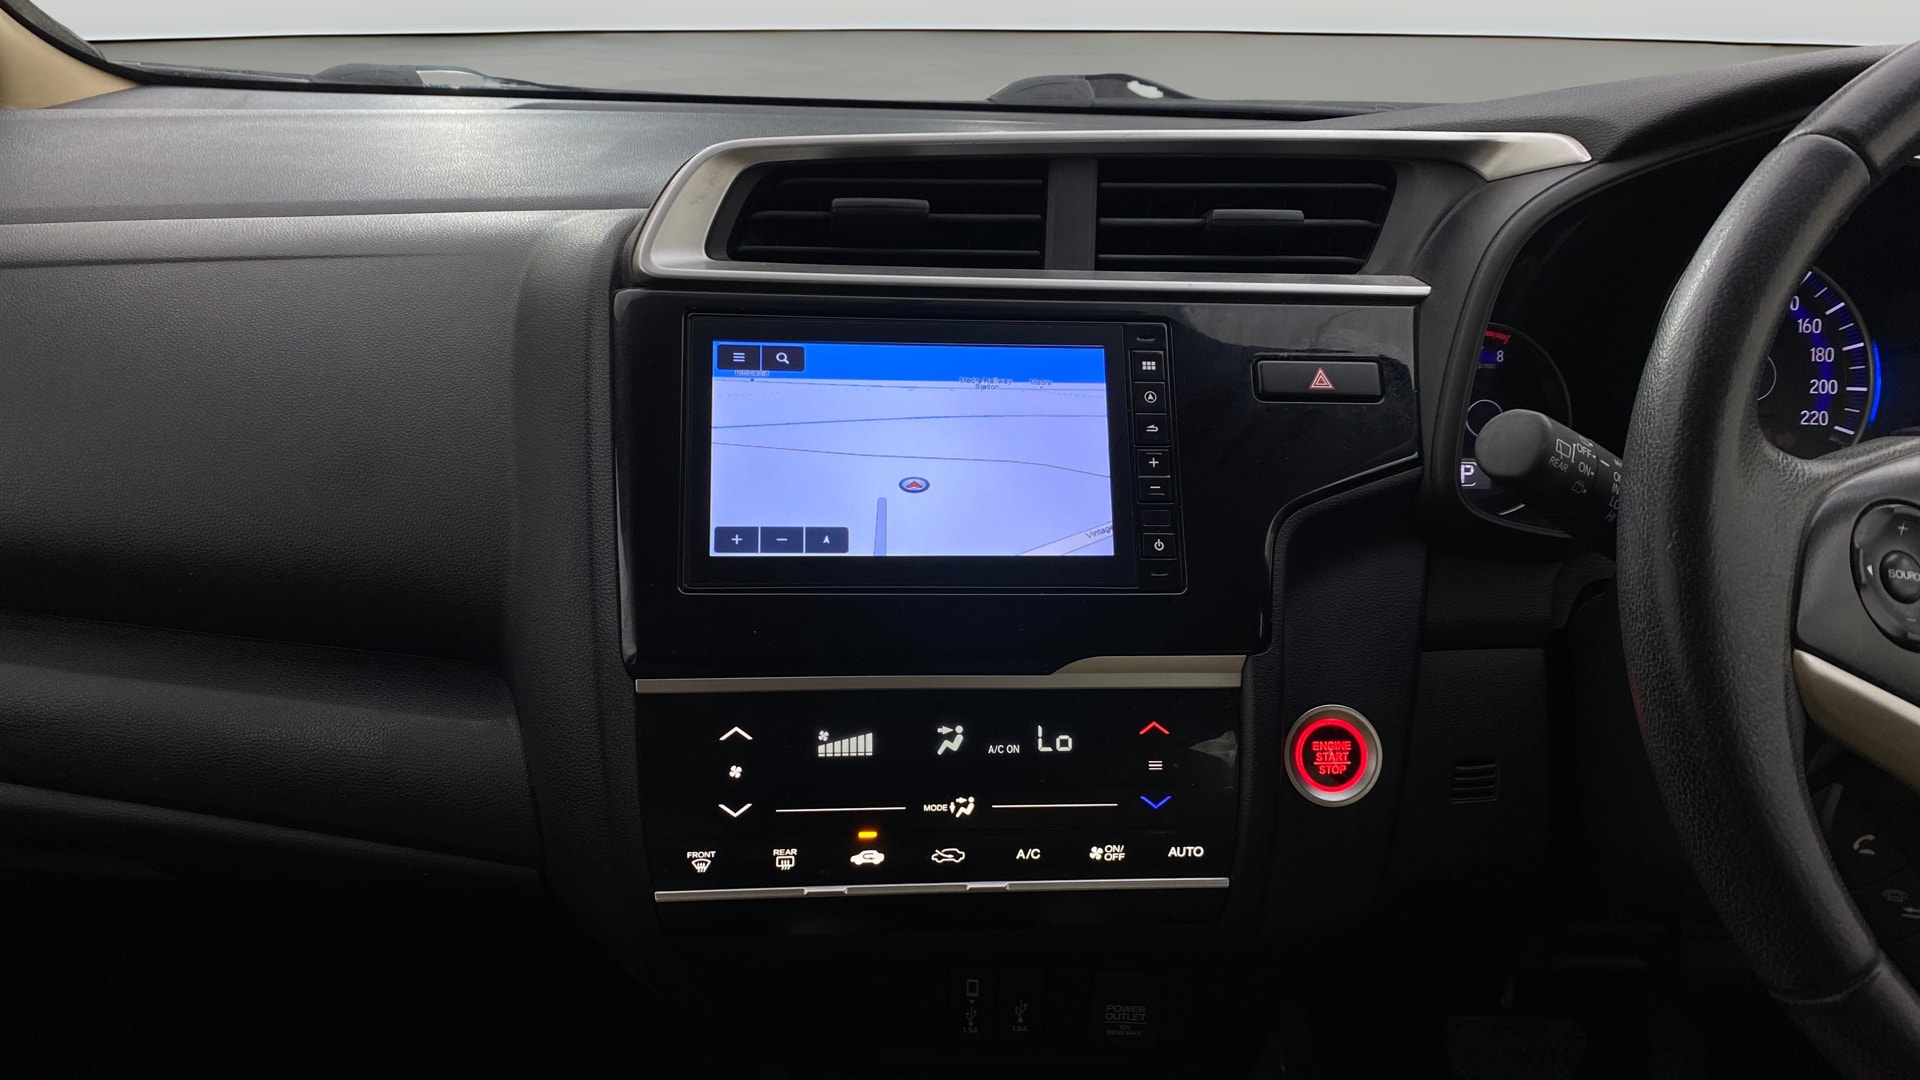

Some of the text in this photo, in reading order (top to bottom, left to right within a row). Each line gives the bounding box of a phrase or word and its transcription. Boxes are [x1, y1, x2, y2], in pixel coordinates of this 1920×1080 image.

[1797, 318, 1822, 334] 160
[1496, 350, 1504, 362] 8
[1810, 347, 1835, 363] 180
[1809, 379, 1838, 394] 200
[1800, 410, 1829, 426] 220
[1576, 443, 1592, 458] OFF
[1548, 455, 1569, 472] REAR
[1578, 461, 1592, 476] ON
[1460, 464, 1474, 484] P
[987, 744, 1020, 754] A/C ON
[1312, 741, 1352, 751] ENGINE
[1315, 751, 1350, 762] START
[1319, 765, 1347, 775] STOP
[923, 803, 949, 812] MODE
[686, 850, 717, 859] FRONT
[773, 848, 798, 856] REAR
[1016, 848, 1041, 860] A/C
[1103, 852, 1126, 861] OFF
[1167, 846, 1205, 857] AUTO
[1106, 1004, 1146, 1013] POWER
[1104, 1012, 1146, 1021] OUTLET
